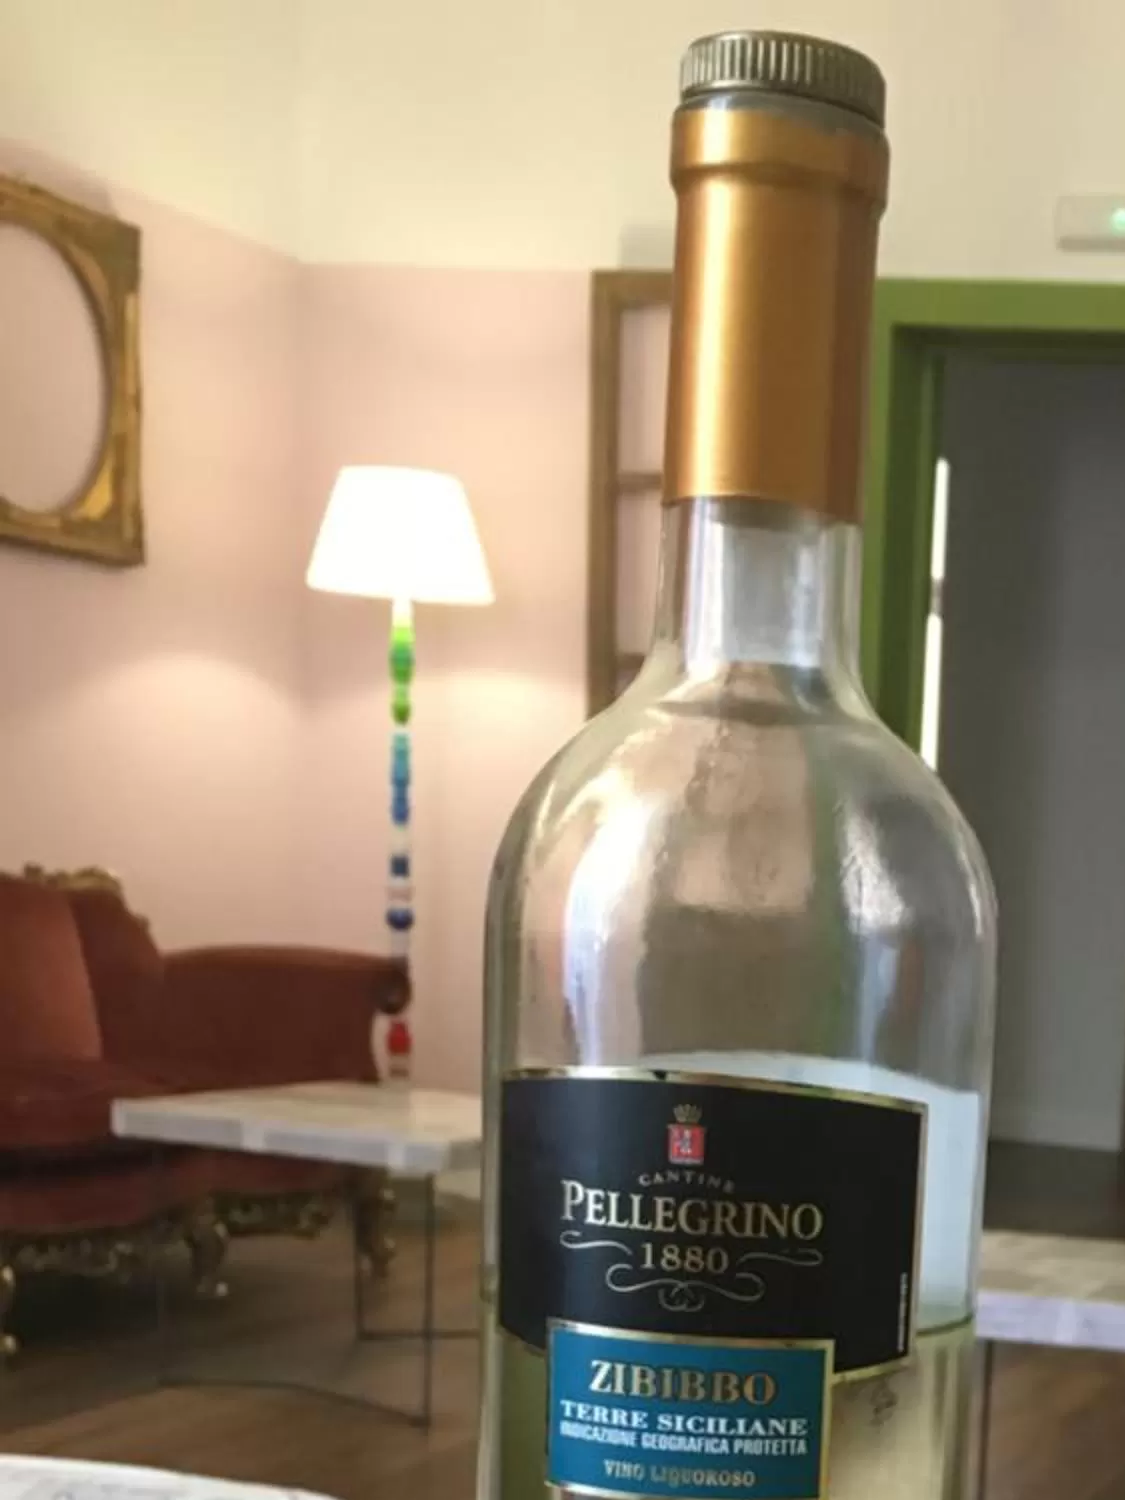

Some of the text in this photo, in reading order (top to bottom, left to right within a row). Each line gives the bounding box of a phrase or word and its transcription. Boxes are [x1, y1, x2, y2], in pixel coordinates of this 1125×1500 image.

[638, 1169, 736, 1193] CANTINE
[560, 1179, 823, 1241] PELLEGRINO
[640, 1243, 730, 1274] 1880
[589, 1359, 778, 1405] ZIBIBBO
[560, 1399, 808, 1436] TERRE SICILIANE
[640, 1431, 730, 1455] GEOGRAFICA
[733, 1438, 808, 1456] PROTETTA
[604, 1459, 645, 1481] VINO
